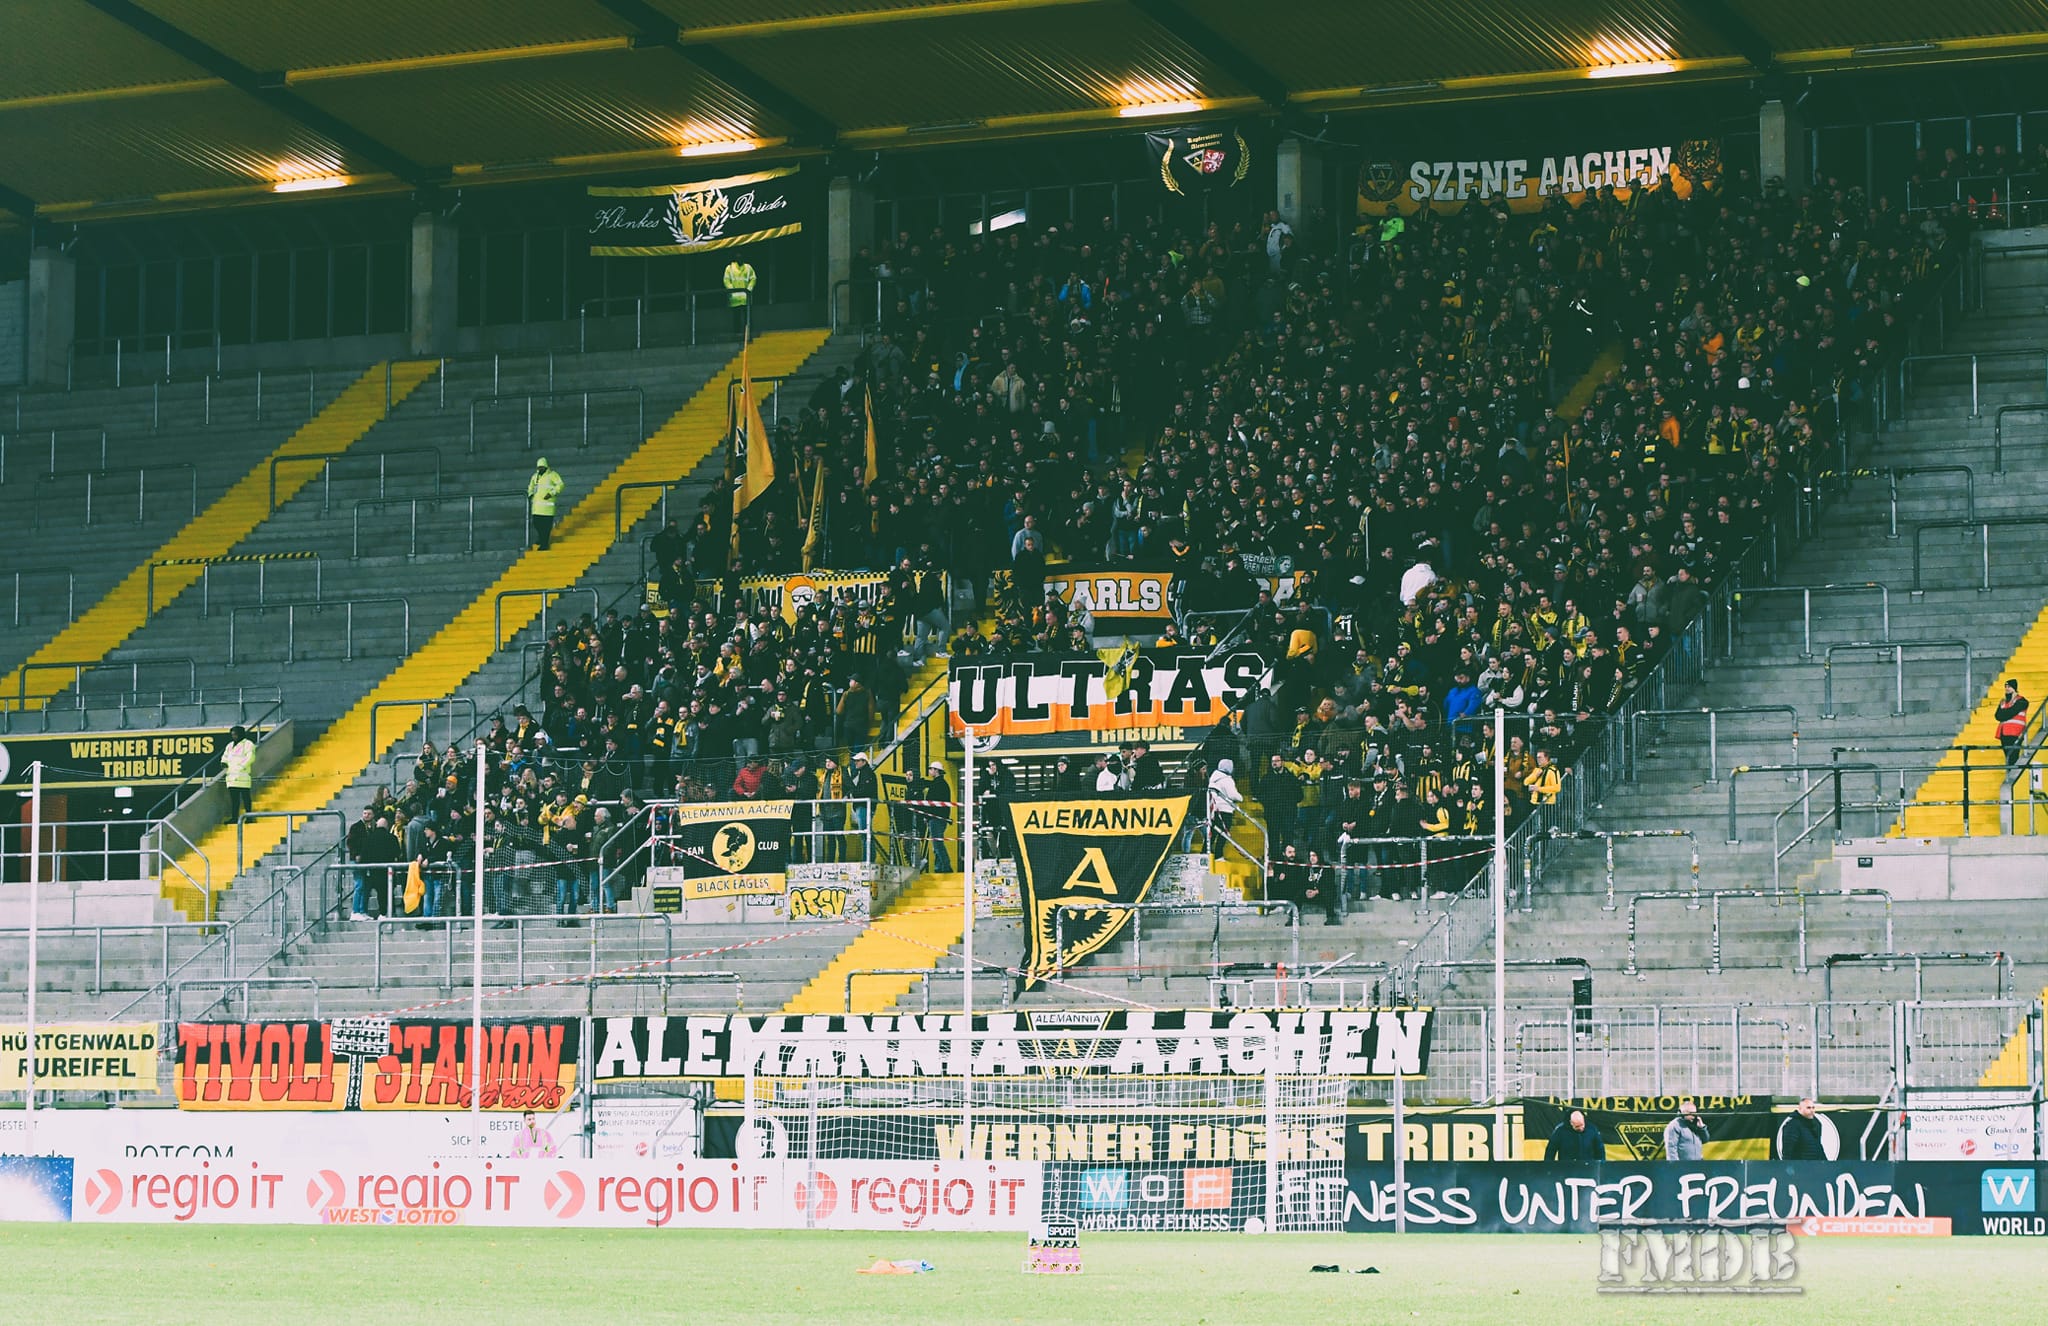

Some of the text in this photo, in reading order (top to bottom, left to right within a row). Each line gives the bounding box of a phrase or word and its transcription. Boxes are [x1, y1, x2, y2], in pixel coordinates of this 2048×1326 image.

[1409, 147, 1671, 201] SZENE AACHEN
[730, 190, 788, 218] Brüder
[1044, 579, 1162, 612] KARLS
[954, 652, 1266, 726] ULTRAS
[70, 737, 214, 758] WERNER FUCHS
[101, 757, 182, 777] TRIBÜNE
[681, 804, 792, 820] ALEMANNIA AACHEN
[1024, 807, 1173, 829] ALEMANNIA
[687, 841, 779, 855] FAN CLUB
[1062, 847, 1118, 894] A
[697, 878, 769, 892] BLACK EAGLES
[1036, 1014, 1101, 1023] ALEMANNIA
[2, 1031, 155, 1051] HÜRTGENWALD
[596, 1010, 1425, 1077] ALEMANNIA AACHEN
[18, 1057, 136, 1077] RUREIFEL
[178, 1022, 564, 1104] TIVOLI STADION
[502, 1085, 565, 1109] 1908
[451, 1135, 487, 1146] SICHR
[935, 1123, 1153, 1161] WERNER
[1169, 1123, 1346, 1162] FUCHS
[1994, 1142, 2020, 1151] beo
[131, 1161, 239, 1220] regio
[598, 1163, 719, 1226] regio
[851, 1164, 975, 1228] regio
[1282, 1170, 1925, 1226] FITNESS UNTER FREUNDEN
[1987, 1175, 2030, 1206] W
[329, 1208, 457, 1224] WEST LOTTO
[1082, 1214, 1230, 1232] WORLD OF FITNESS
[1821, 1220, 1935, 1234] camcontrol
[1982, 1217, 2047, 1235] WORLD
